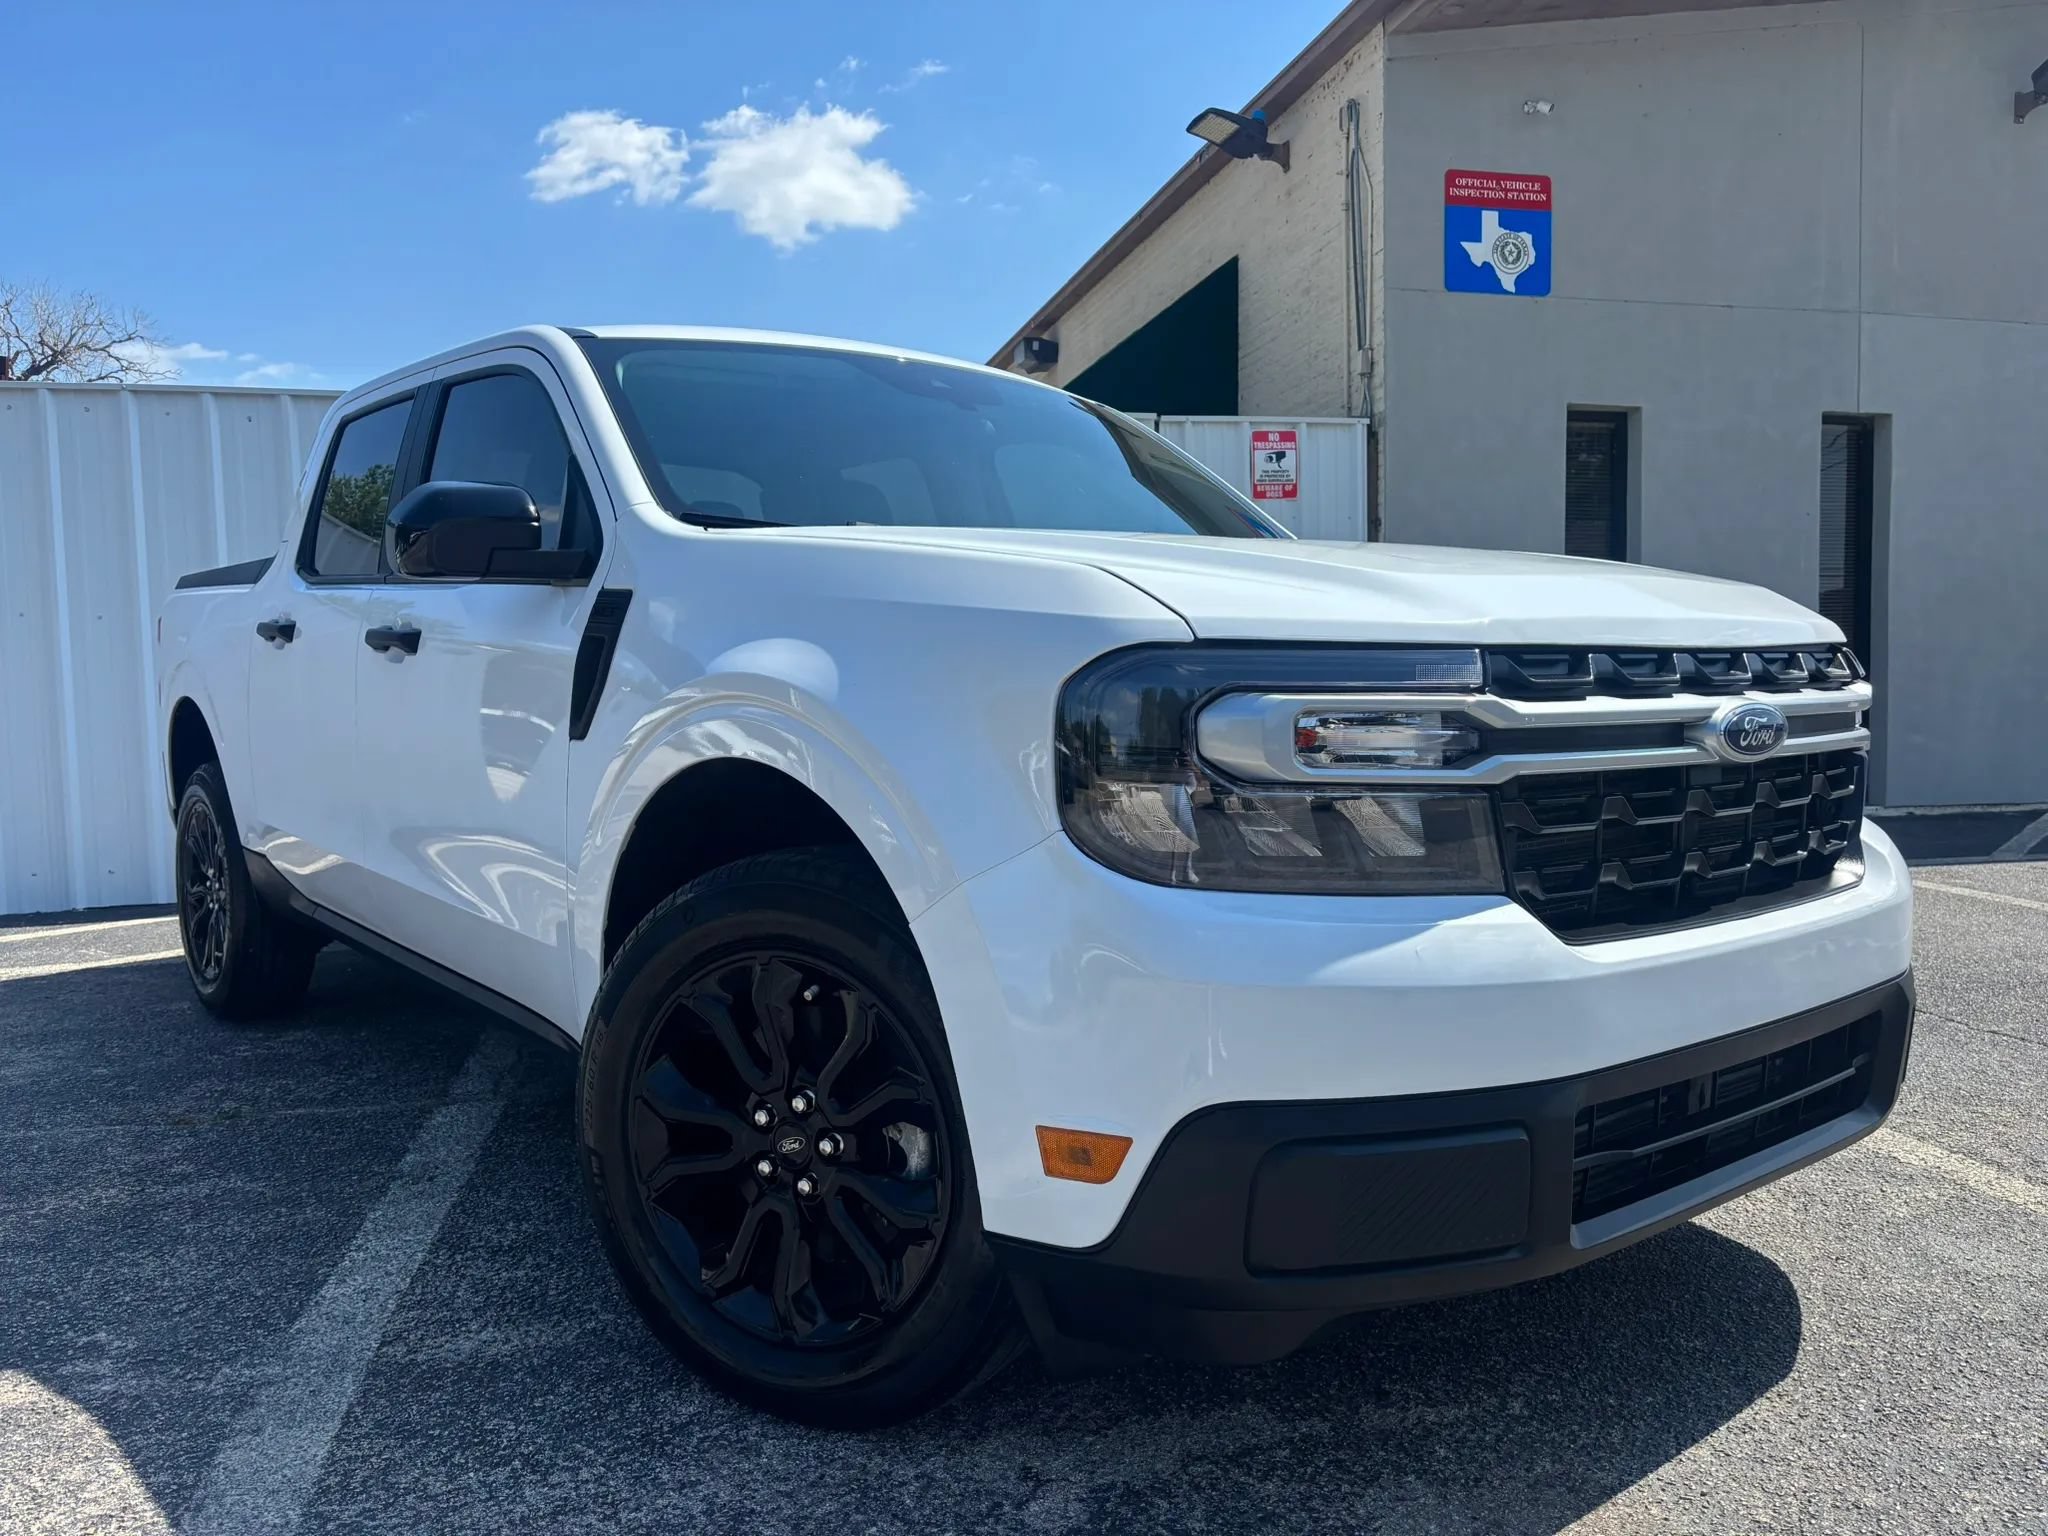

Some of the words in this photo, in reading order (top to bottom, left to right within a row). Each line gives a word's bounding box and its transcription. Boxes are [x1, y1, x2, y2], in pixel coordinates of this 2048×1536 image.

[1455, 177, 1497, 188] OFFICIAL
[1500, 181, 1541, 191] VEHICLE
[1449, 187, 1506, 199] INSPECTION
[1507, 191, 1547, 202] STATION
[1268, 432, 1280, 441] NO
[1740, 716, 1777, 747] Ford
[781, 1139, 800, 1152] Ford
